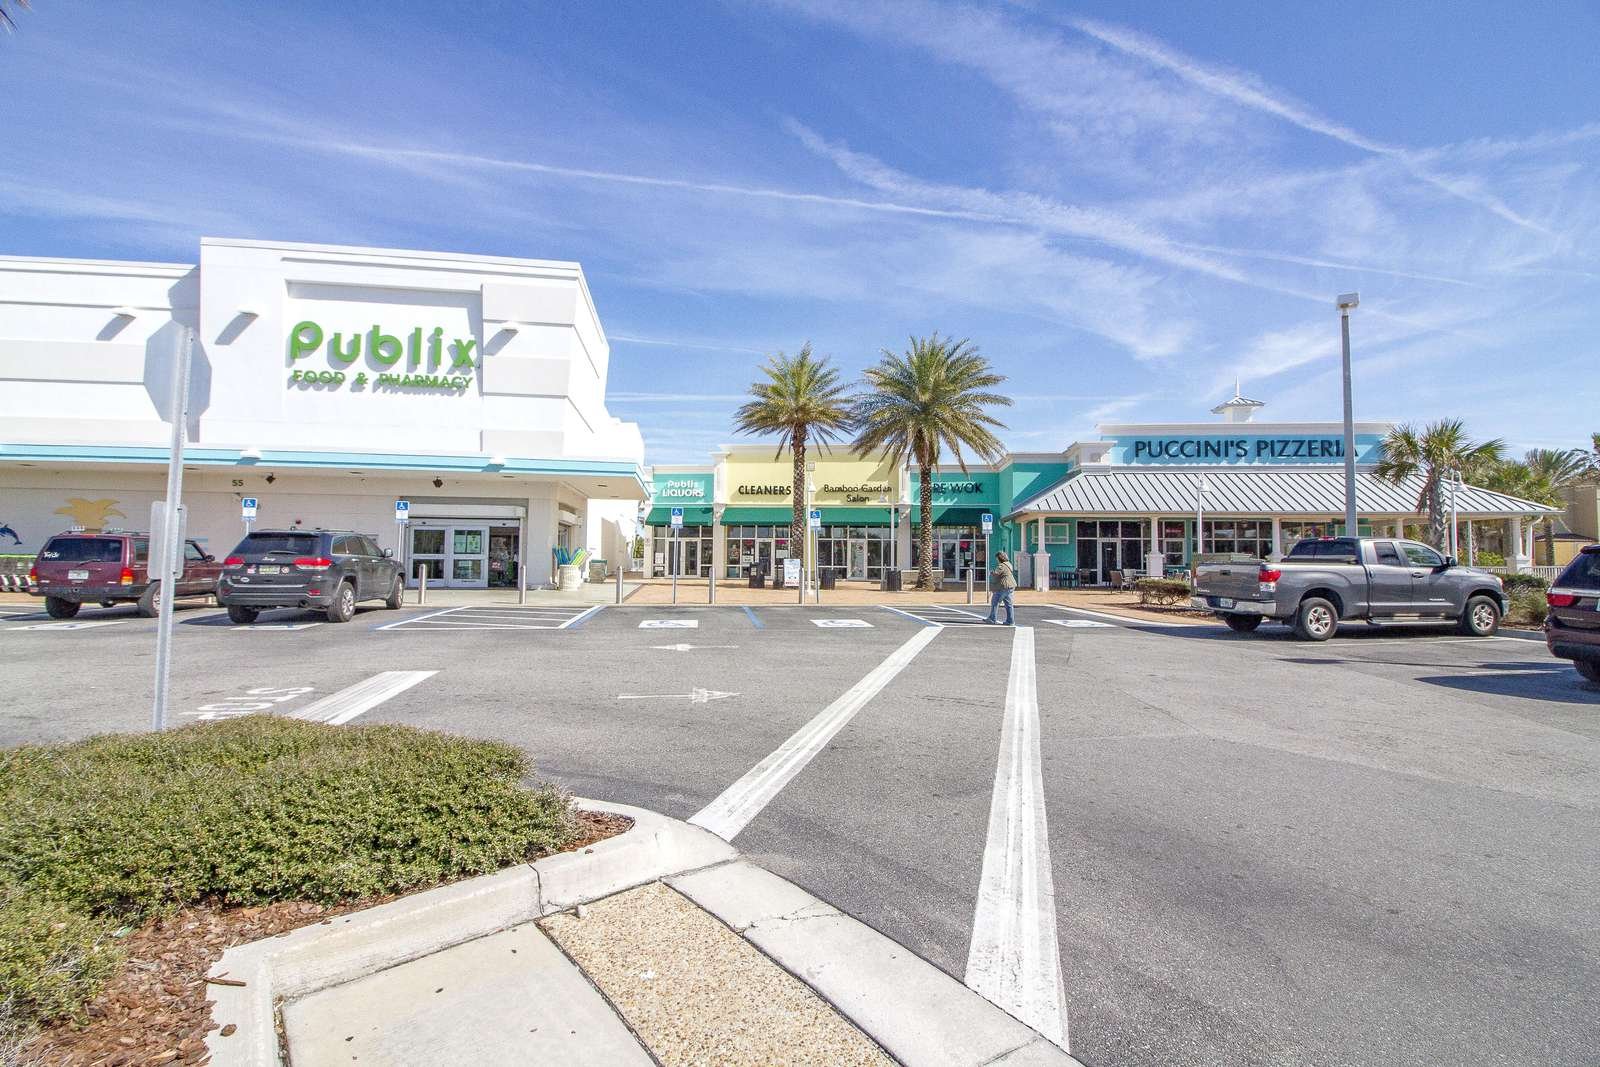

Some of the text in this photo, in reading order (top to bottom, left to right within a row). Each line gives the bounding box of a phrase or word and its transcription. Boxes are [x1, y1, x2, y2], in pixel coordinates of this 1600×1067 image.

[290, 321, 476, 368] Publix
[293, 370, 473, 389] FOOD & PHARMACY
[1135, 440, 1249, 458] PUCCINI'S
[232, 479, 244, 487] 55
[823, 484, 859, 492] Bamboo
[662, 488, 704, 497] LIQUORS
[738, 485, 792, 495] CLEANERS
[950, 483, 983, 494] WOK
[846, 494, 870, 502] Salon
